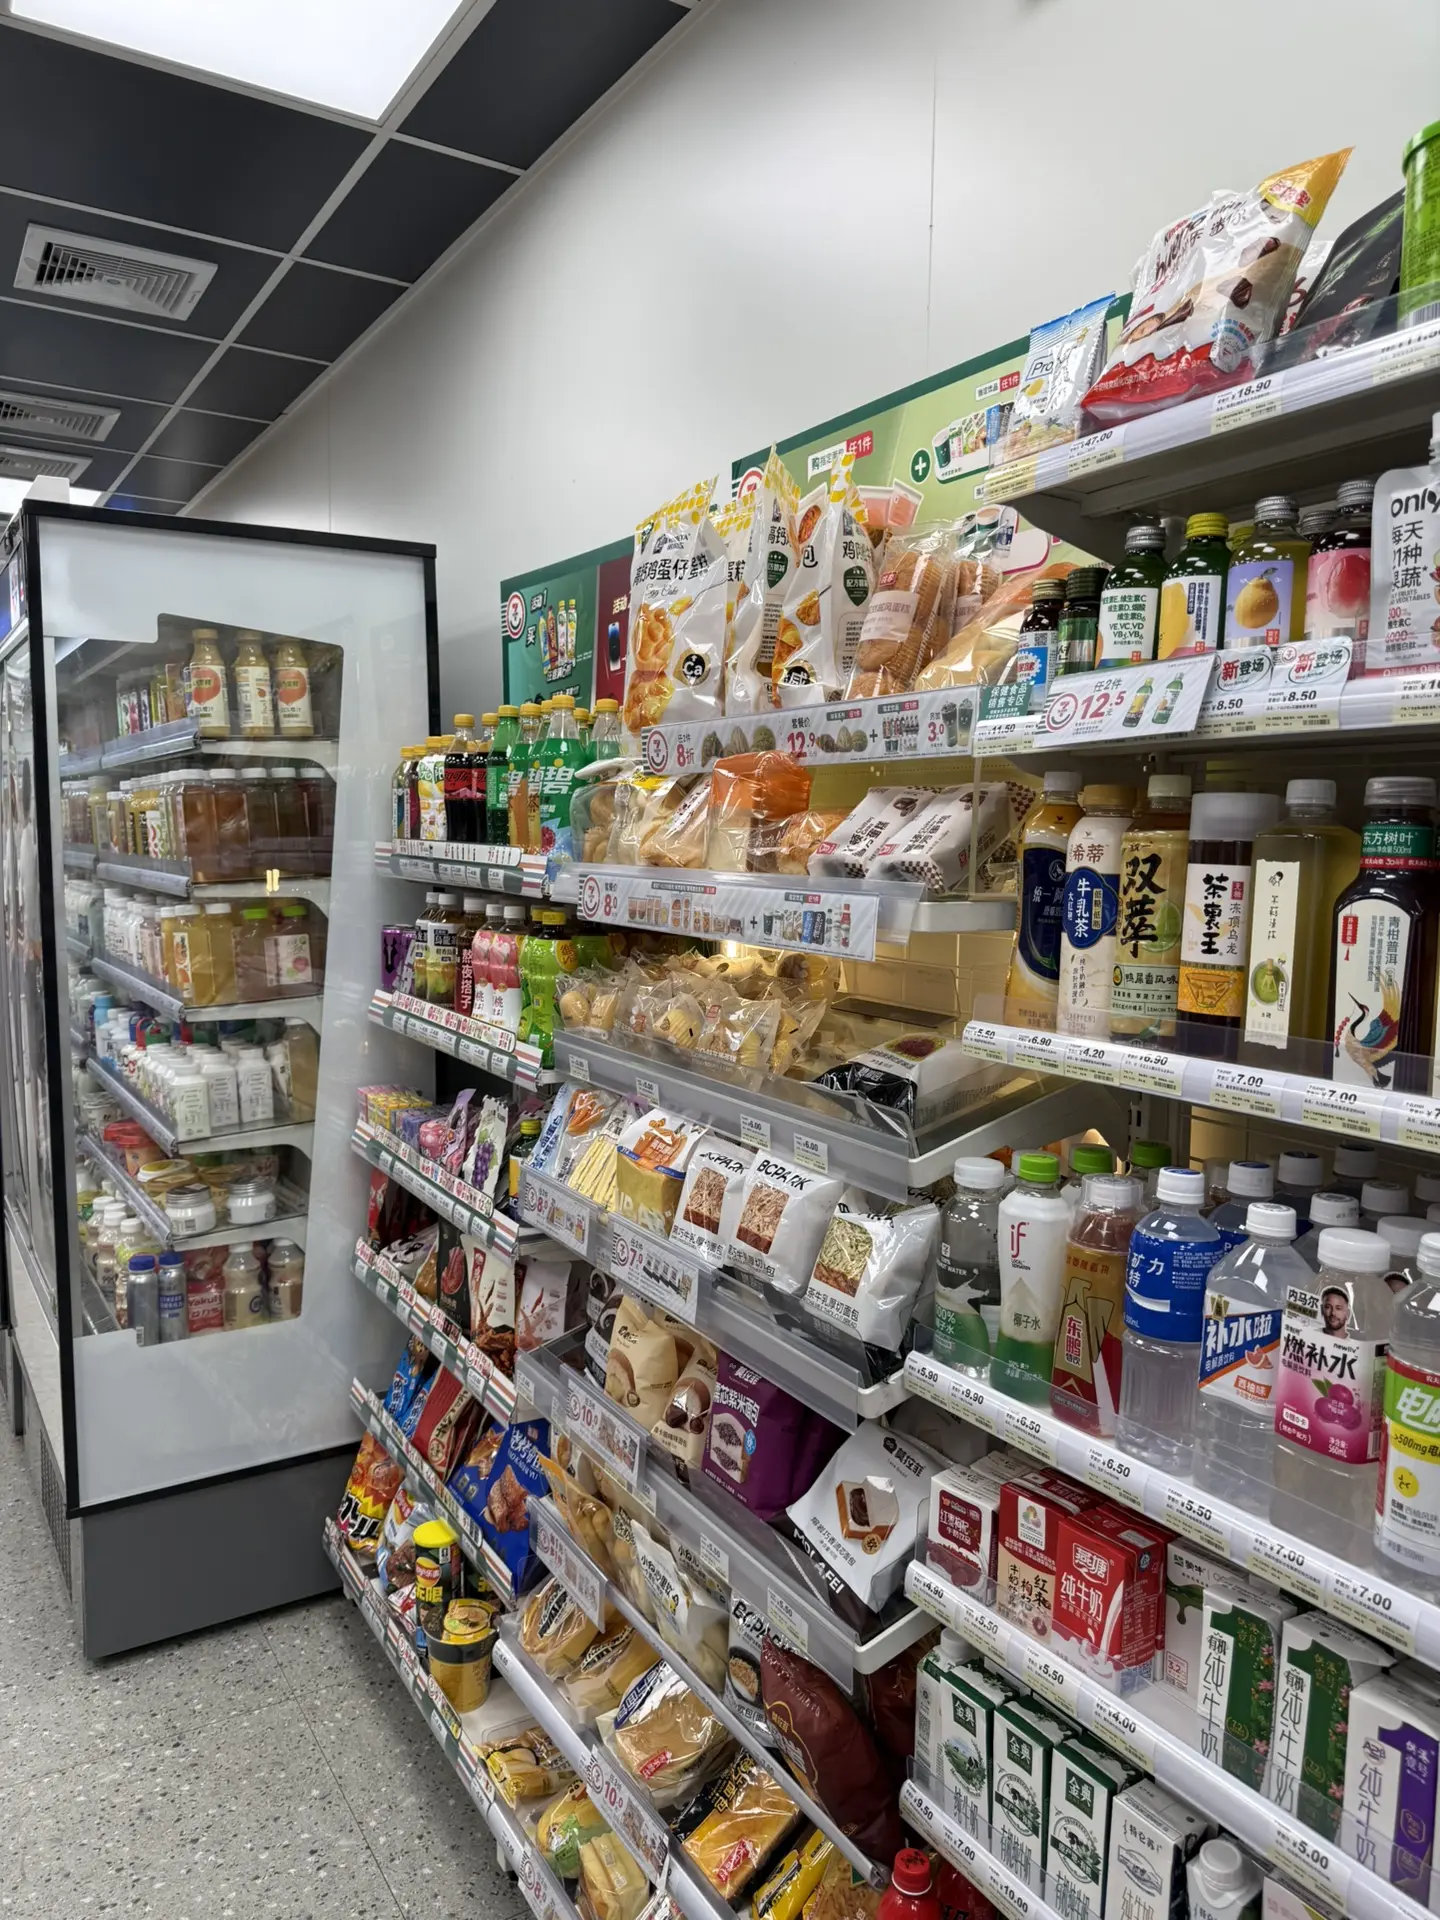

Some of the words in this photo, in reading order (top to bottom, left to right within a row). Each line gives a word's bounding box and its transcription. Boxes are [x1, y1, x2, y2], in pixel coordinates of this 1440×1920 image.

[1000, 373, 1020, 389] 任1件
[1231, 379, 1272, 401] ¥18.90
[847, 433, 873, 455] 任1件
[682, 660, 704, 677] Ca
[1222, 658, 1265, 682] 新登场
[1294, 650, 1343, 676] 新登场
[991, 684, 1028, 697] 保健食品
[1094, 678, 1121, 692] 任2件
[1282, 690, 1317, 703] ¥8.50
[988, 694, 1025, 709] 销售专区
[1080, 691, 1126, 720] 12.5
[1211, 697, 1243, 712] ¥8.50
[676, 744, 695, 767] 8折
[787, 731, 816, 758] 12.9
[1363, 831, 1414, 846] 东方树叶
[1074, 878, 1091, 938] 牛乳茶
[1201, 873, 1230, 955] 茶裏王
[1226, 902, 1242, 955] 冻顶乌龙
[1385, 916, 1400, 966] 青柑普洱
[1028, 1036, 1052, 1047] ¥6.90
[1079, 1047, 1105, 1059] ¥4.20
[1230, 1073, 1264, 1088] ¥7.00
[1322, 1089, 1358, 1105] ¥7.00
[756, 1159, 813, 1192] BCPARK
[1010, 1222, 1027, 1258] if
[1288, 1289, 1319, 1309] 内马尔
[1013, 1312, 1041, 1331] 椰子水
[1066, 1316, 1083, 1357] 东鹏
[1206, 1314, 1272, 1357] 补水啦
[1065, 1352, 1081, 1367] 特饮
[1283, 1333, 1357, 1381] 燃补水
[916, 1366, 938, 1383] ¥5.90
[960, 1388, 985, 1405] ¥9.90
[1015, 1416, 1042, 1434] ¥6.50
[1102, 1457, 1131, 1478] ¥6.50
[1180, 1500, 1212, 1521] ¥5.50
[1074, 1547, 1107, 1579] 燕塘
[1268, 1542, 1306, 1567] ¥7.00
[922, 1580, 944, 1600] ¥4.90
[1060, 1571, 1104, 1622] 纯牛奶
[1352, 1584, 1393, 1612] ¥7.00
[974, 1616, 998, 1635] ¥5.50
[1038, 1663, 1064, 1686] ¥5.50
[953, 1699, 977, 1728] 金典
[1107, 1710, 1136, 1734] ¥4.00
[1008, 1735, 1033, 1764] 金典
[1067, 1776, 1094, 1804] 金典
[913, 1796, 935, 1821] ¥9.50
[953, 1838, 976, 1862] ¥7.00
[1291, 1839, 1329, 1870] ¥5.00
[999, 1881, 1029, 1913] ¥10.00
